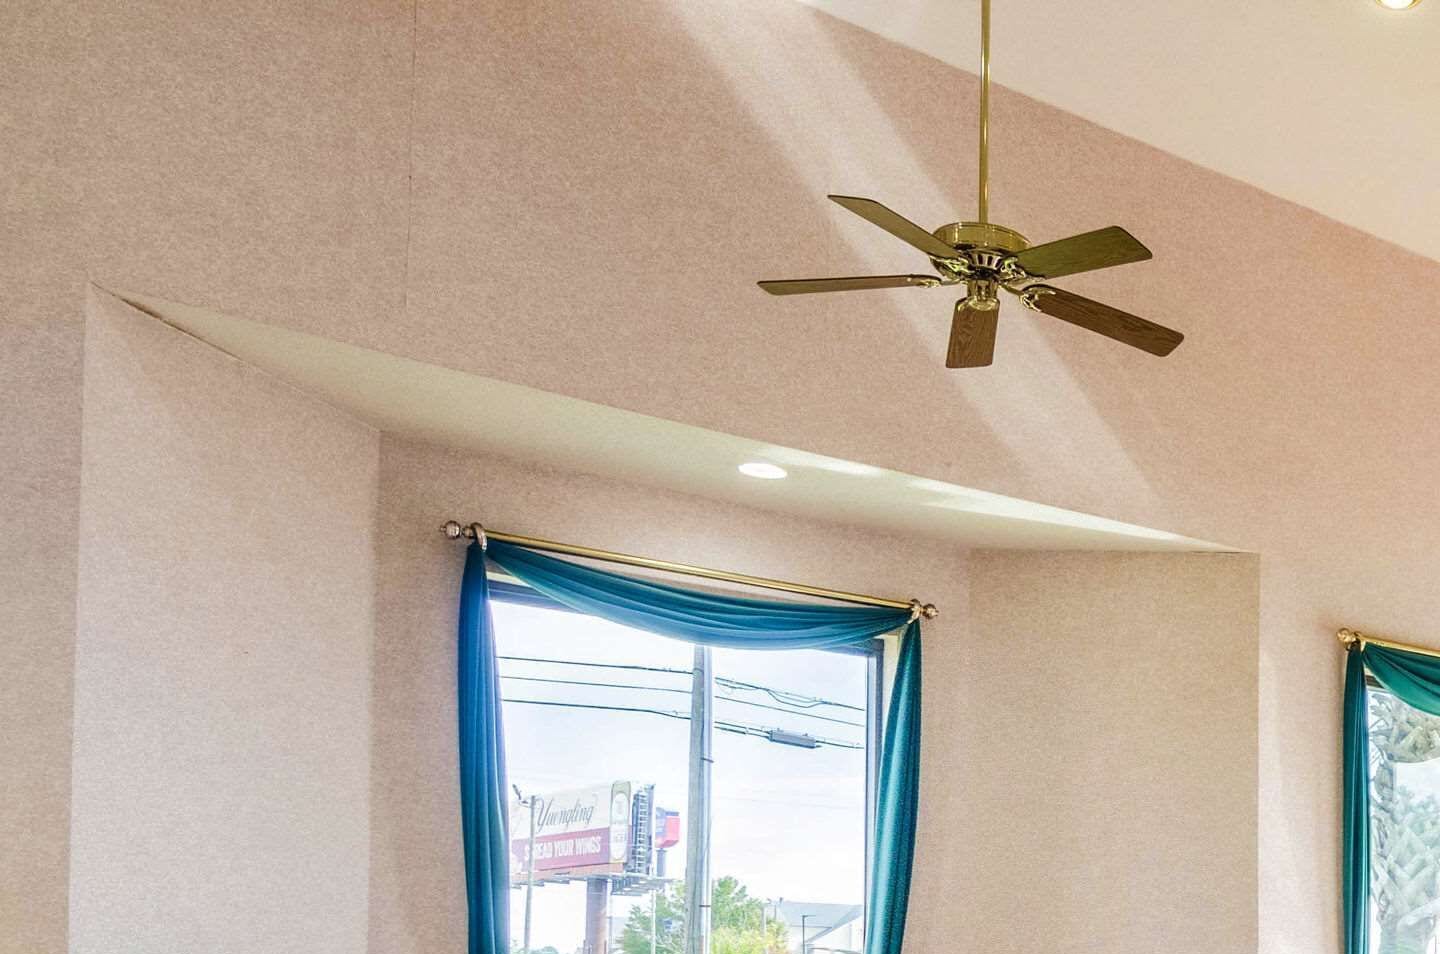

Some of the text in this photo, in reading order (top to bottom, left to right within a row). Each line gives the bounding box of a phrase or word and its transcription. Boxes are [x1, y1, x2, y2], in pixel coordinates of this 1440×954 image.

[535, 796, 596, 832] Yuengling
[524, 842, 553, 861] SREAD
[554, 839, 574, 858] YOUR
[575, 836, 602, 856] WINGS
